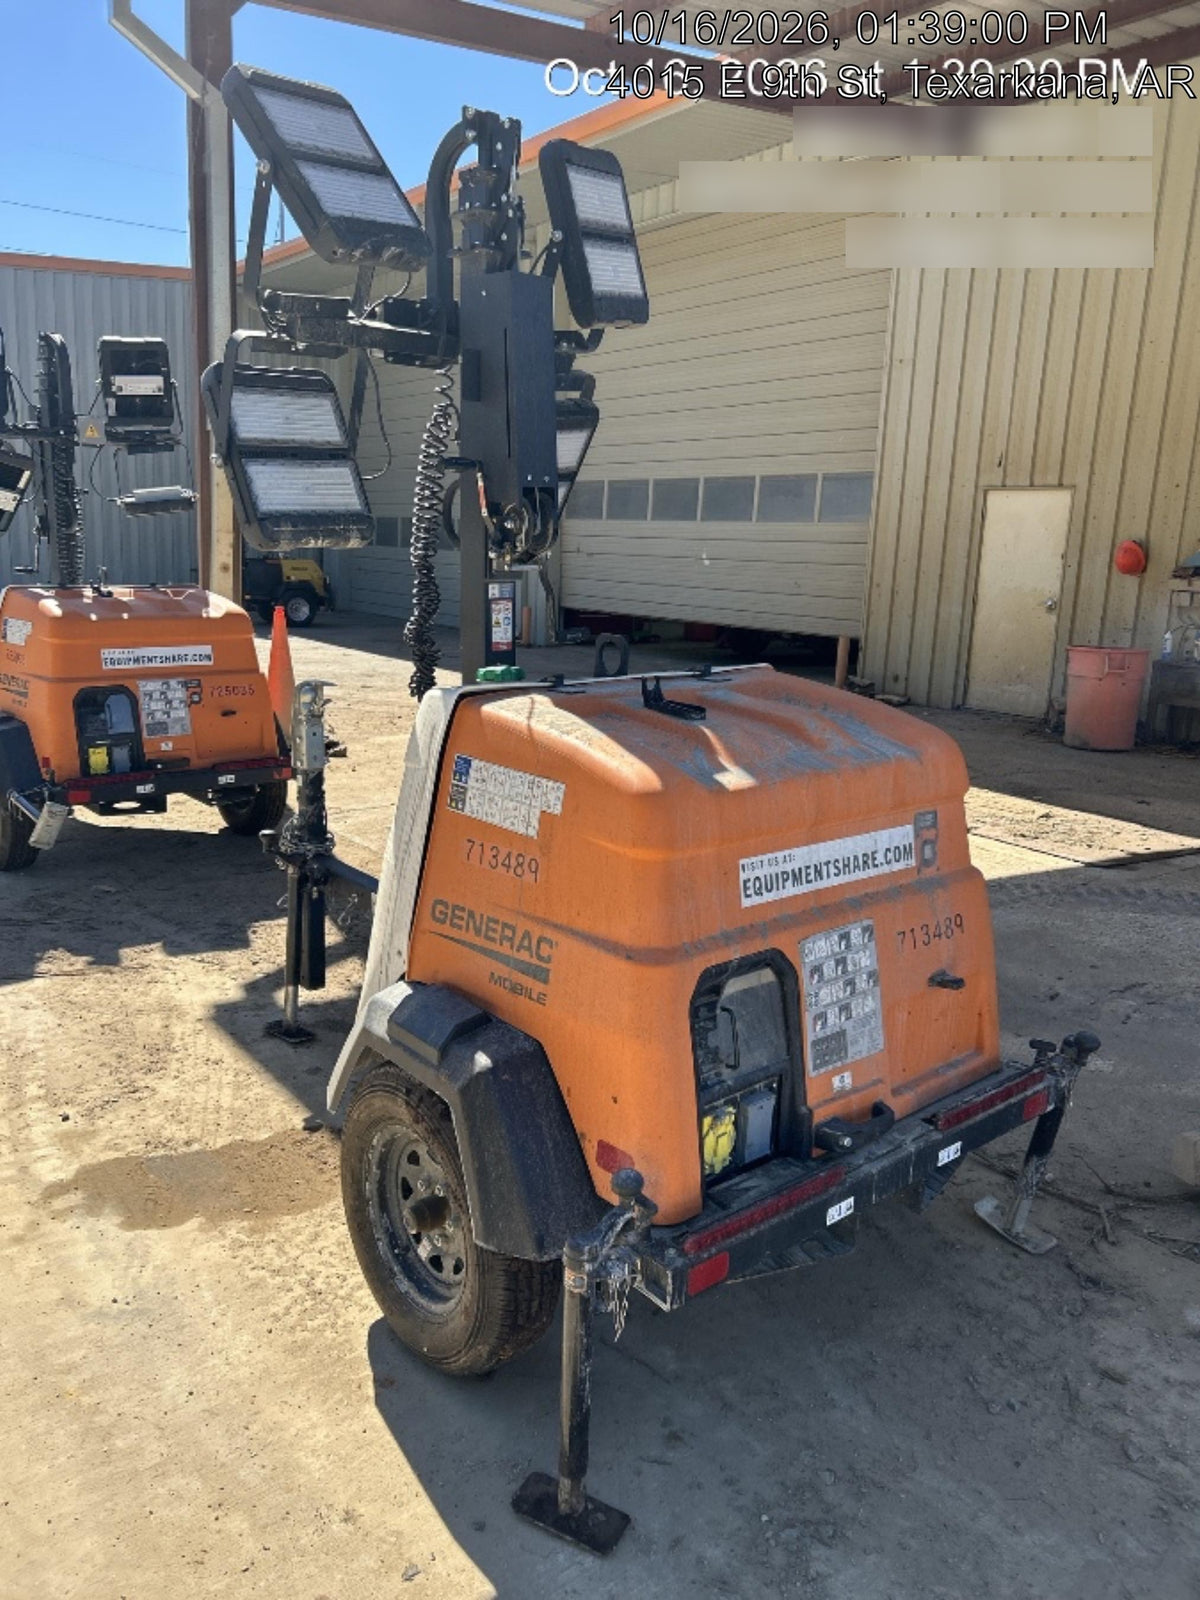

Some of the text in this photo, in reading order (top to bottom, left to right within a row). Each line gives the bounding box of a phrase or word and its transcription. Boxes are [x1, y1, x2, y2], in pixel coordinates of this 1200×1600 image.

[465, 838, 540, 883] 713489
[741, 859, 764, 873] VISIT
[768, 856, 779, 868] US
[743, 842, 913, 899] EQUIPMENTSHARE.COM
[430, 898, 554, 964] GENERAC
[896, 913, 965, 949] 713489
[489, 971, 548, 1007] MOBILE
